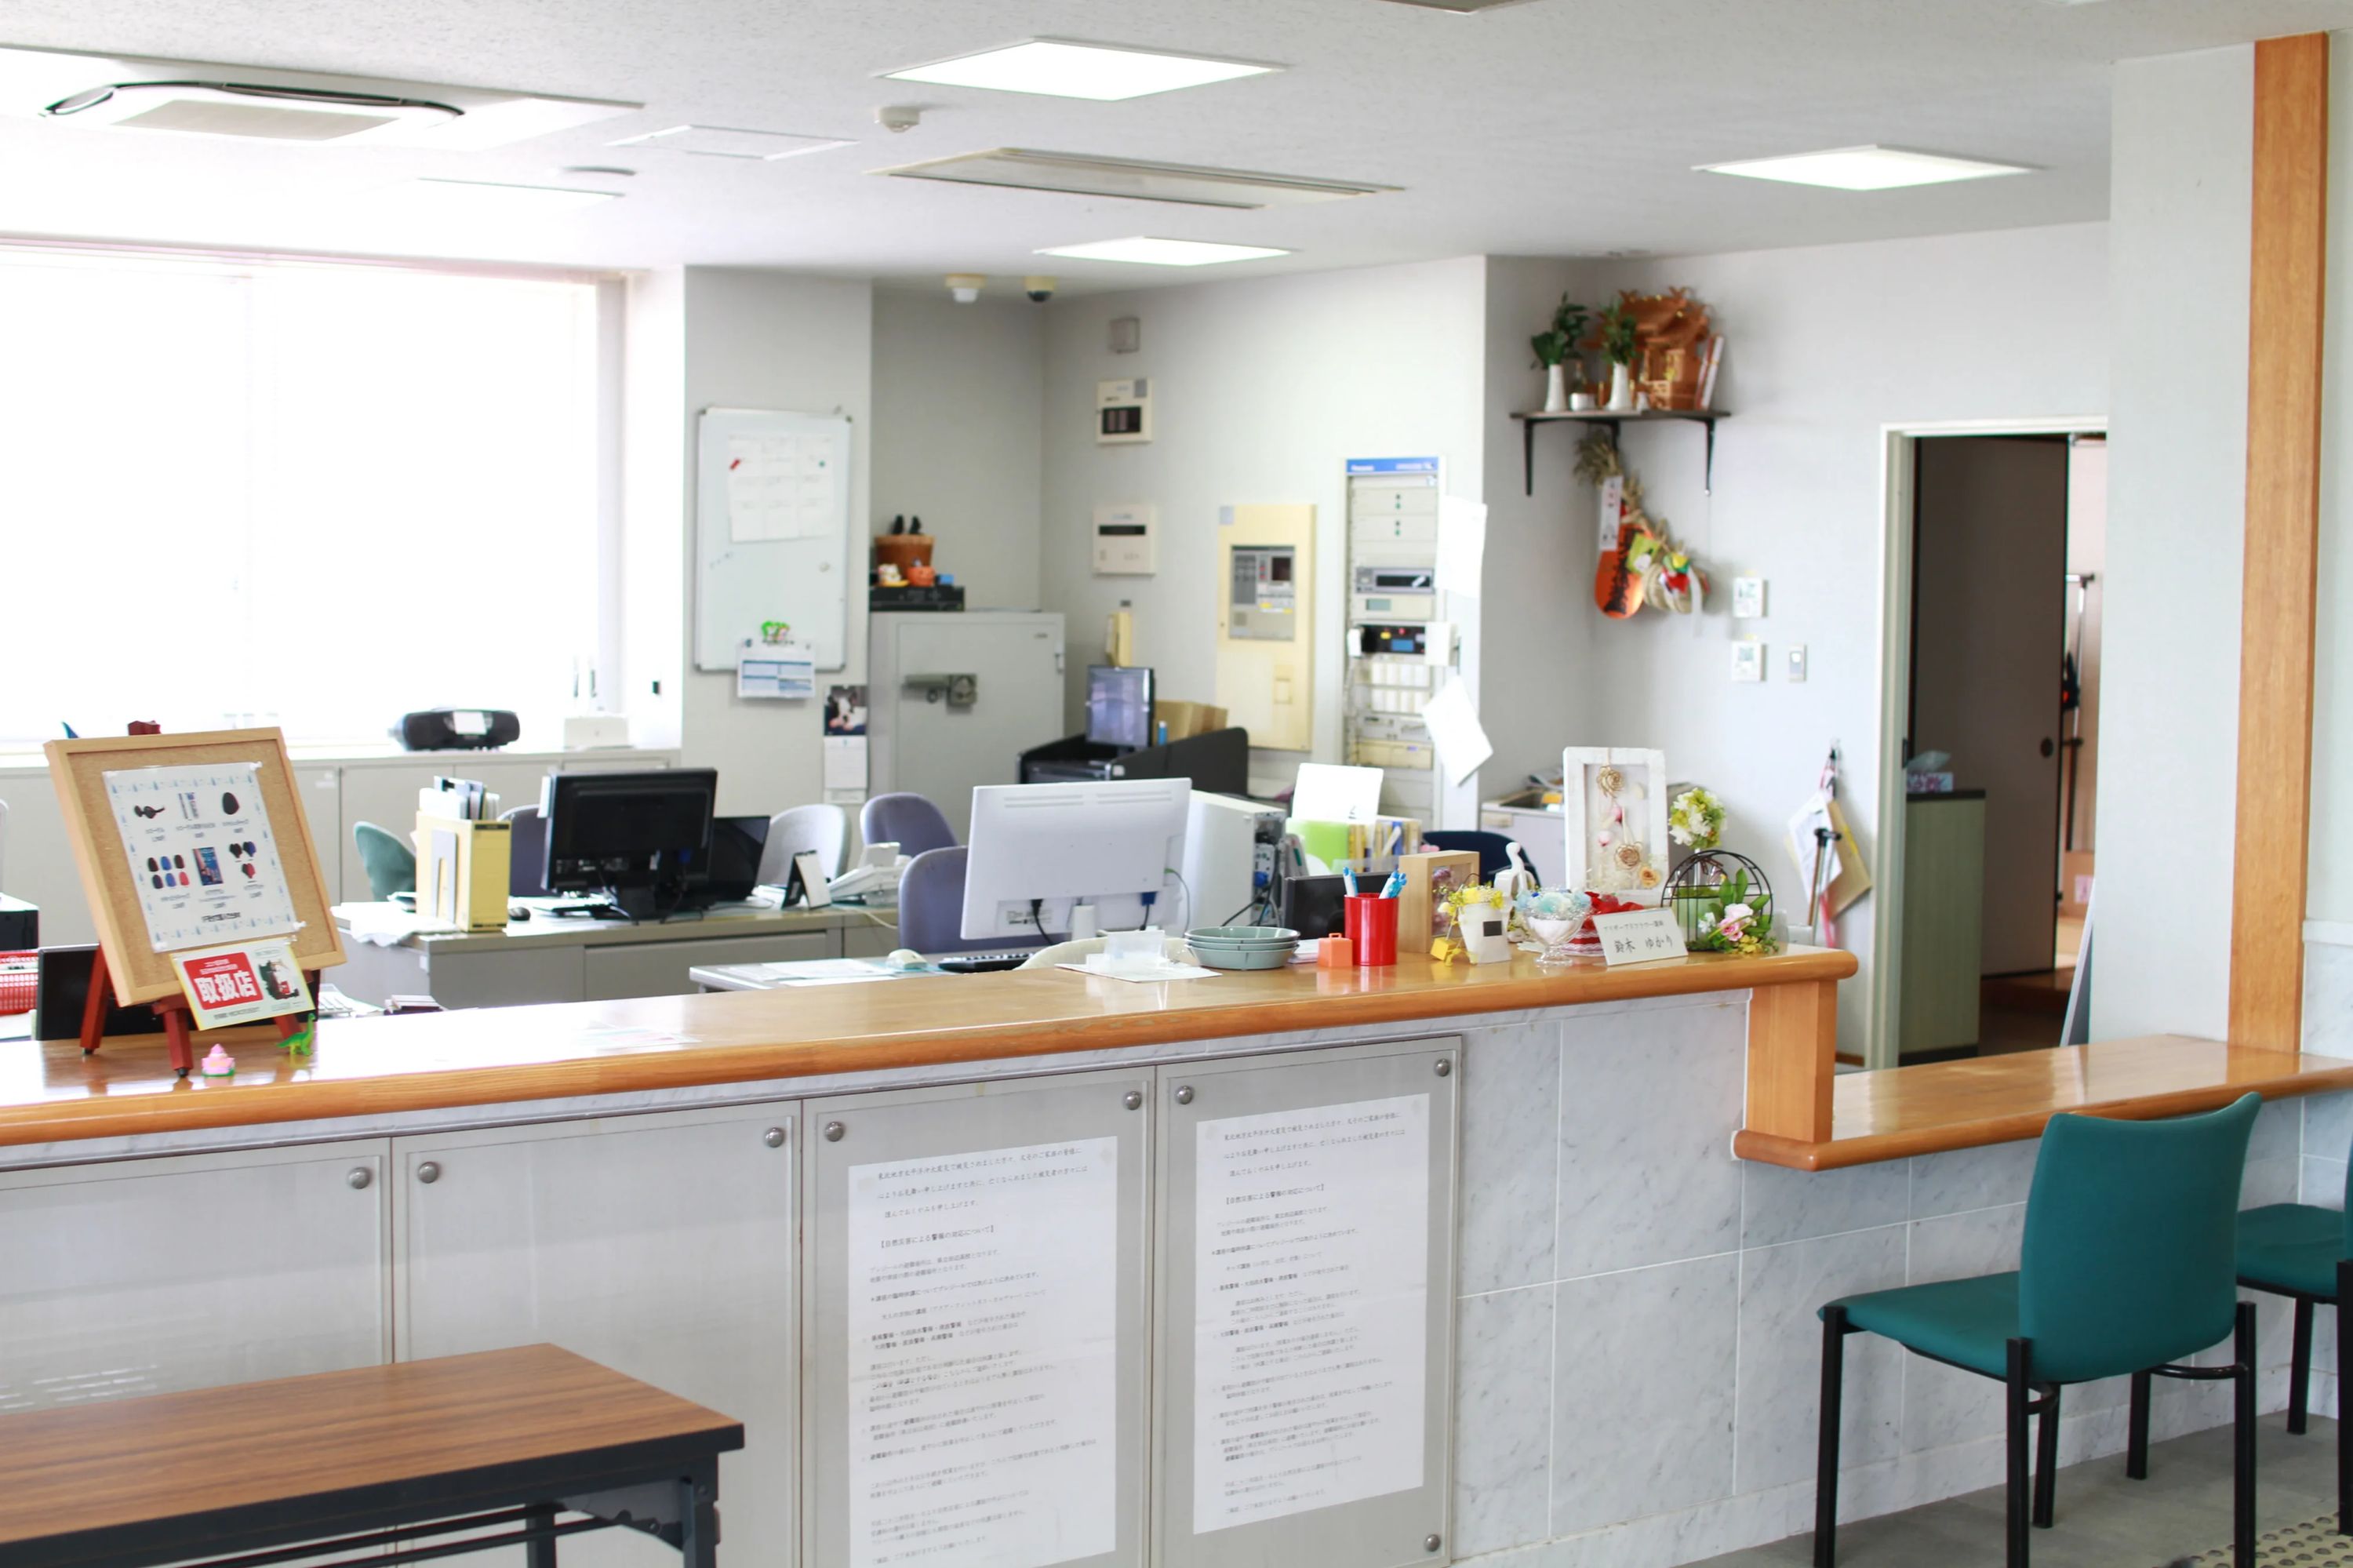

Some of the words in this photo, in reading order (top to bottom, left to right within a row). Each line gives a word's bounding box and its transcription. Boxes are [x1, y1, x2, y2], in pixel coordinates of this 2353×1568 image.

[1613, 937, 1636, 953] 鈴木
[195, 970, 257, 1003] 取扱店
